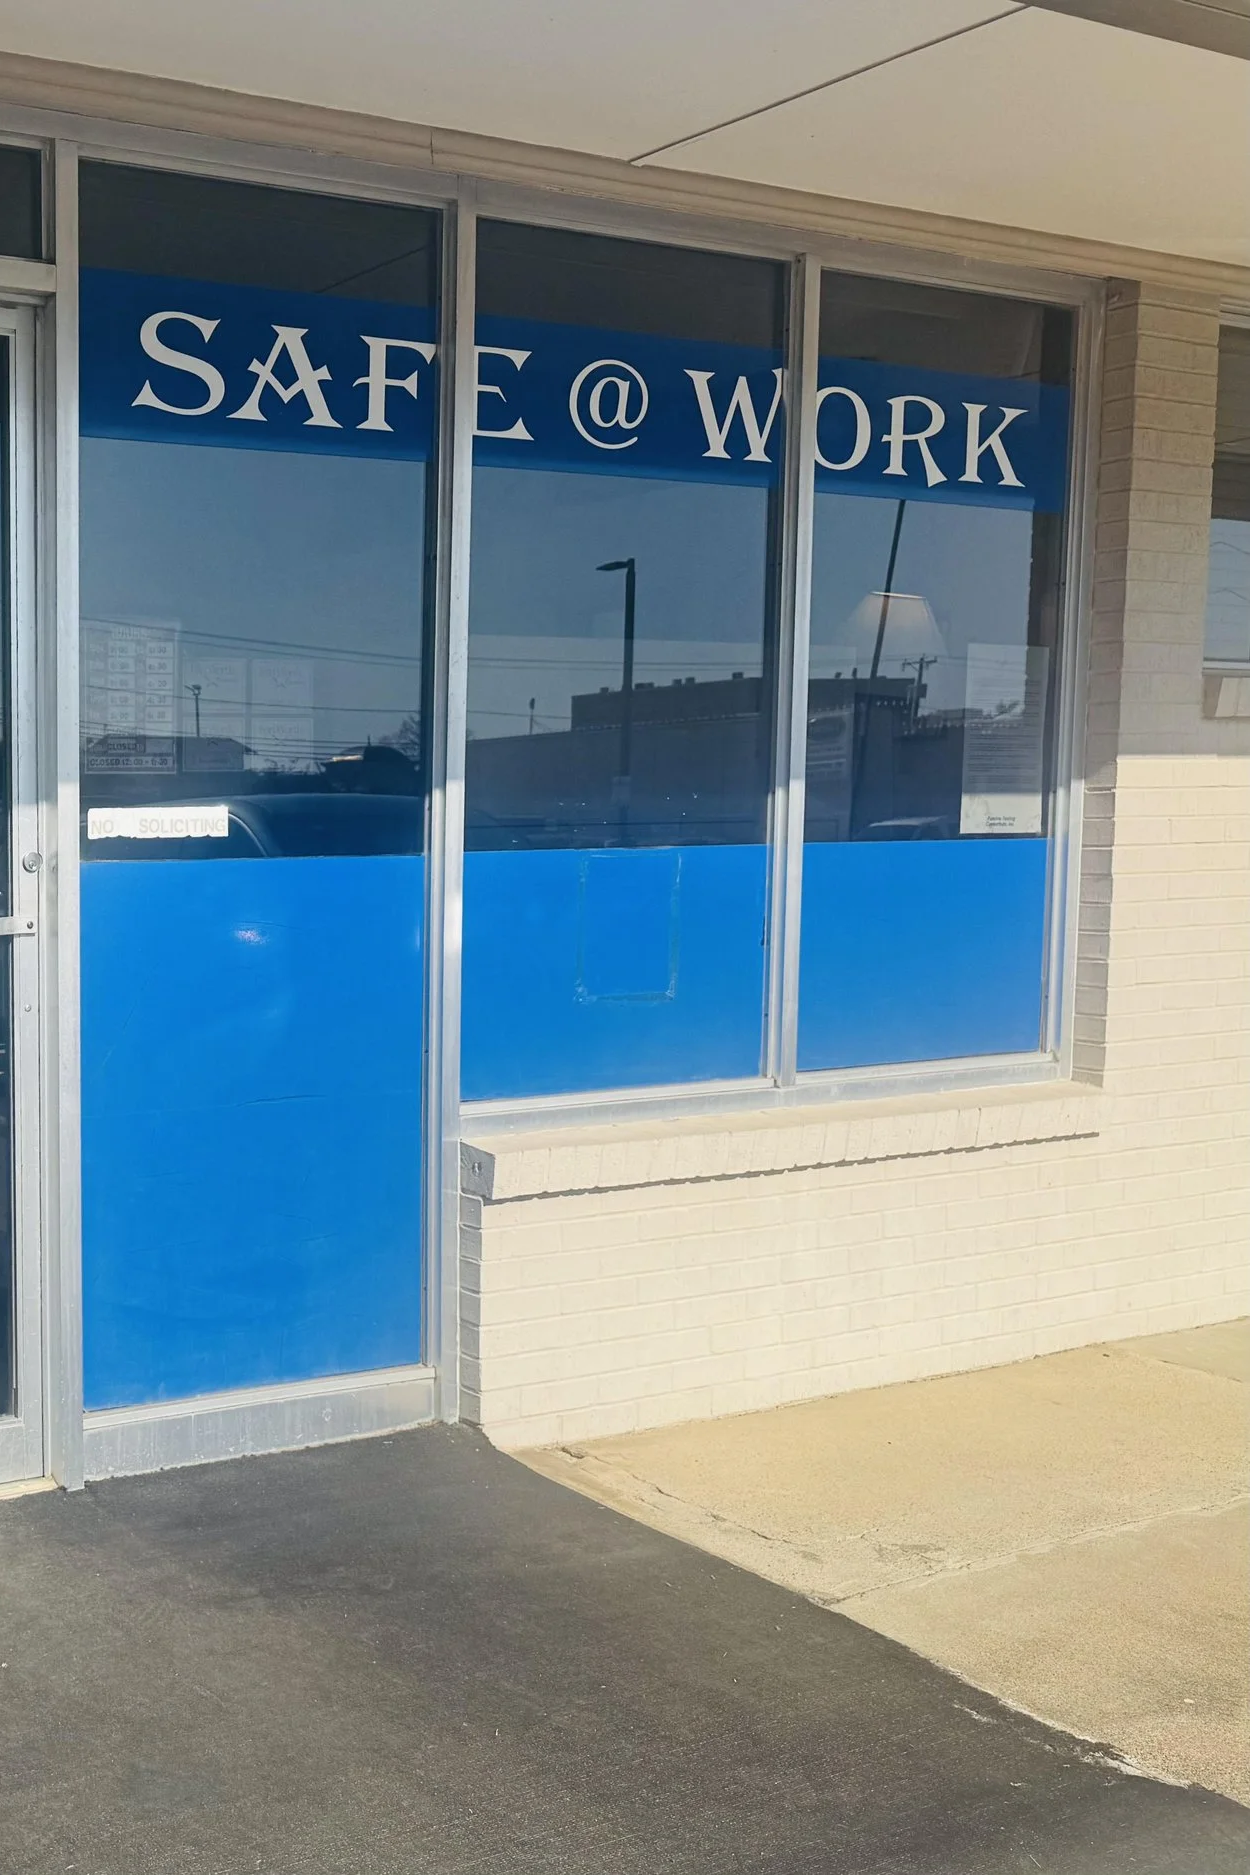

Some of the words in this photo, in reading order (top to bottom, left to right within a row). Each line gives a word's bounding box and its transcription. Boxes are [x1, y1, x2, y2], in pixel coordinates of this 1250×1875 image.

[131, 310, 534, 442] SAFE
[568, 359, 648, 450] @
[683, 366, 1029, 489] WORK
[91, 820, 114, 836] NO
[138, 818, 227, 834] SOLICITING
